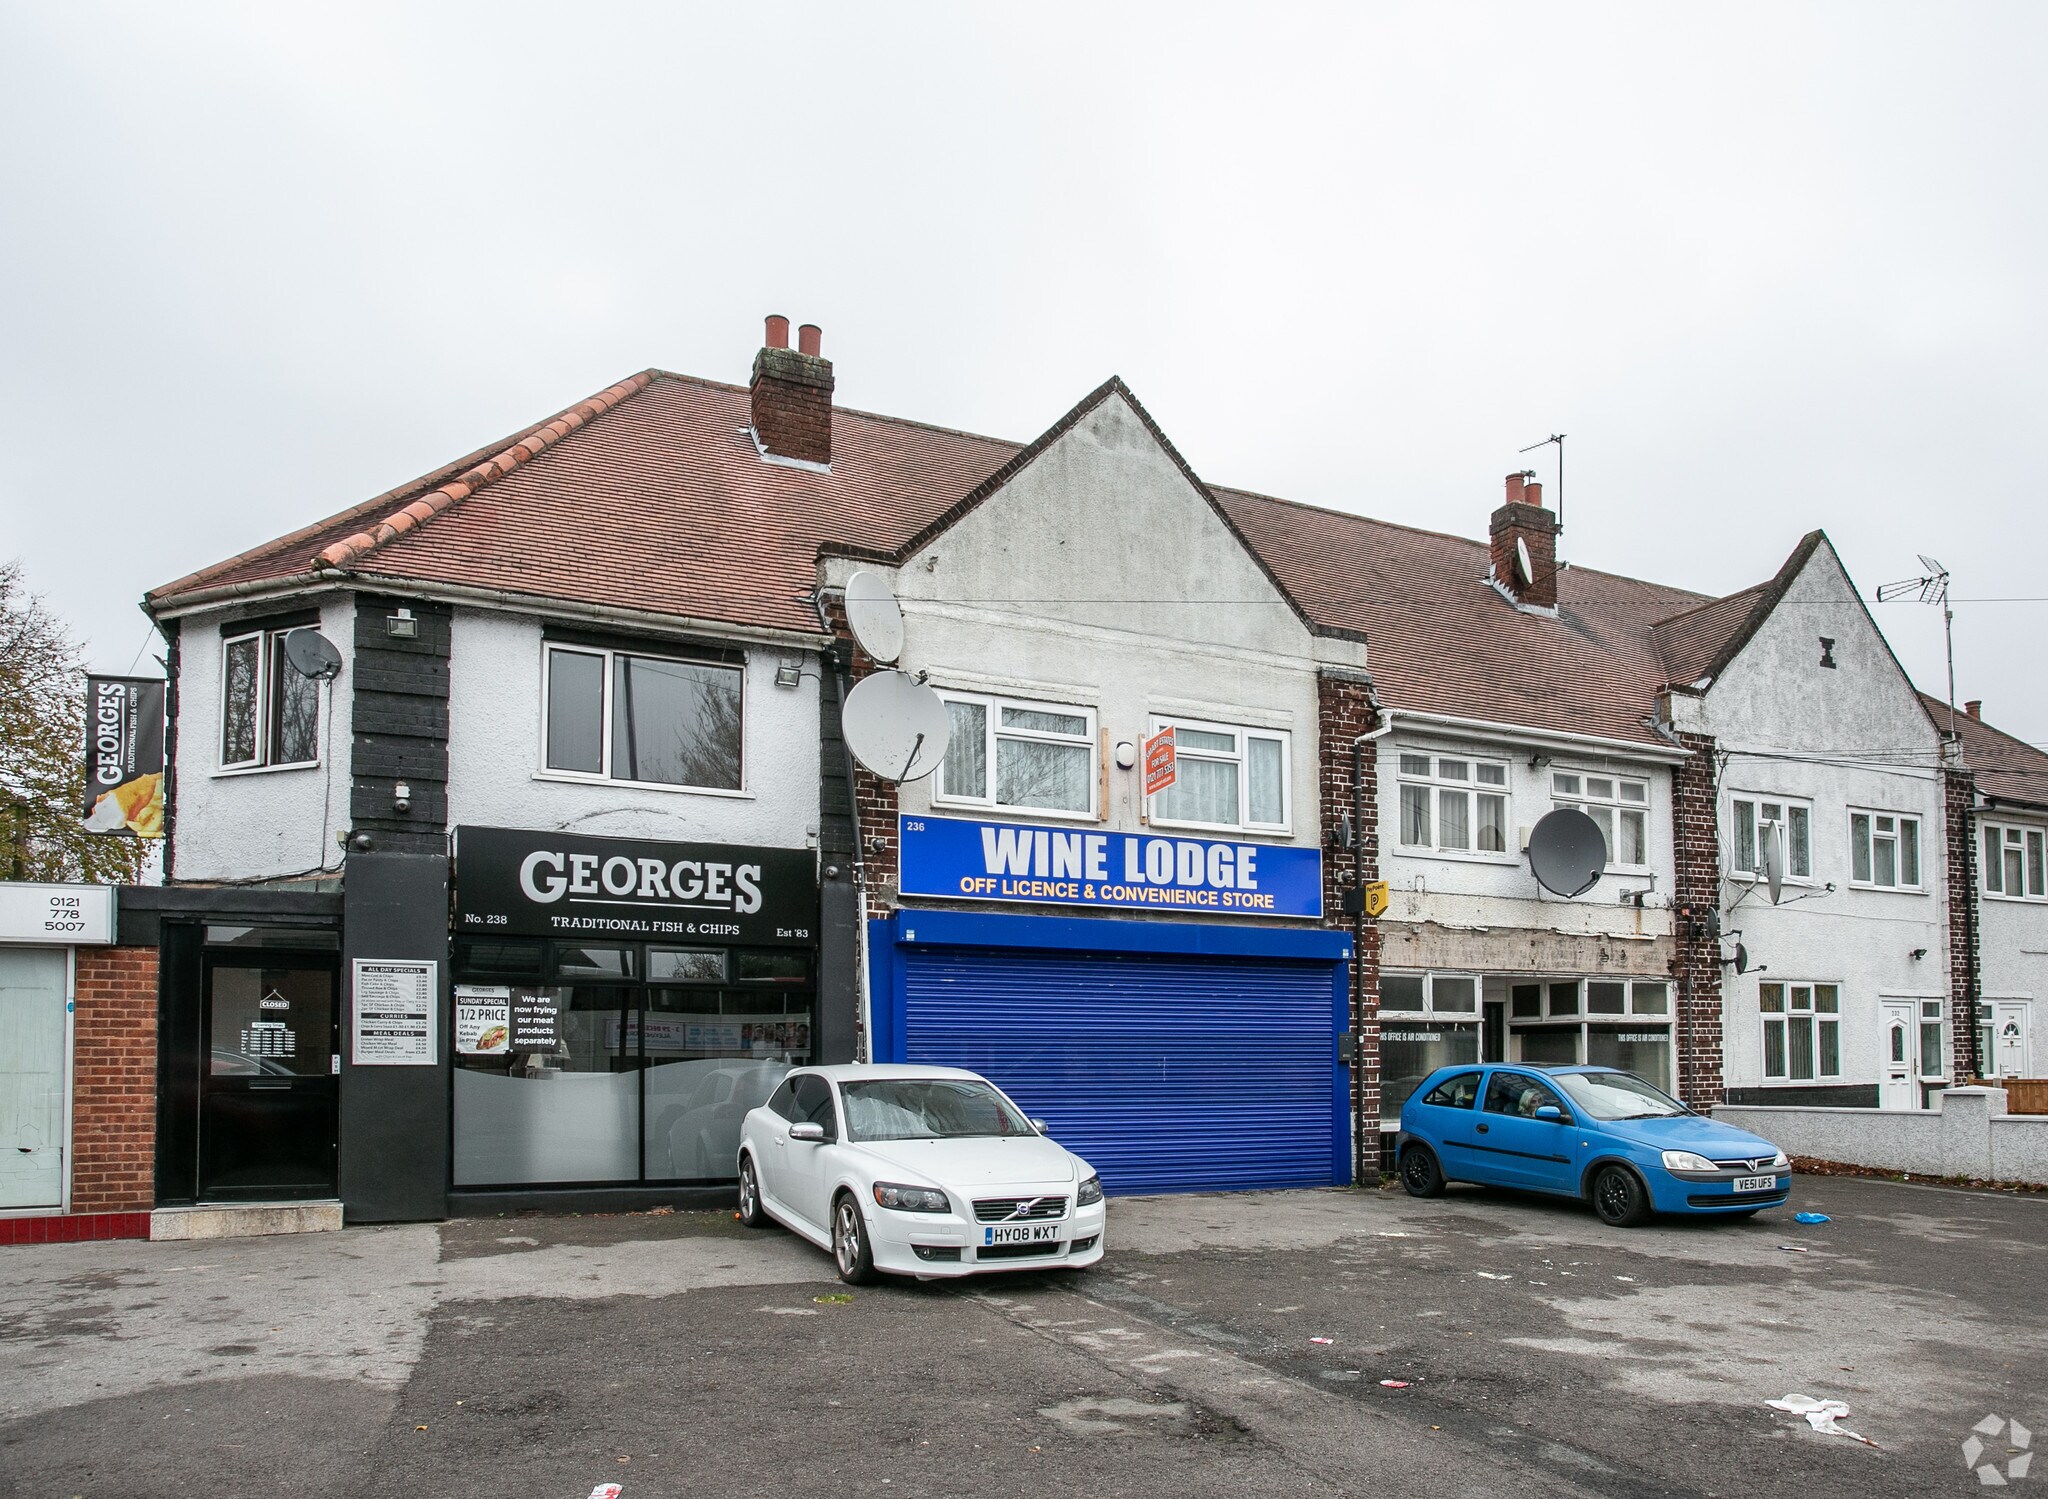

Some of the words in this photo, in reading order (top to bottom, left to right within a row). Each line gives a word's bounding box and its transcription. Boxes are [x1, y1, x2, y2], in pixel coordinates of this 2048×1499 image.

[130, 687, 138, 707] CHIPS
[96, 683, 126, 785] GEORGES
[128, 730, 137, 773] TRADITIONAL
[1159, 752, 1169, 764] SALE
[906, 822, 925, 832] 236
[981, 827, 1107, 880] WINE
[1125, 837, 1257, 890] LODGE
[520, 851, 762, 914] GEORGES
[1367, 883, 1384, 893] PayPoint
[960, 877, 996, 894] OFF
[1003, 880, 1079, 898] LICENCE
[1083, 884, 1096, 899] &
[1100, 886, 1218, 906] CONVENIENCE
[1222, 892, 1274, 908] STORE
[50, 897, 80, 906] 0121
[50, 910, 80, 919] 778
[465, 914, 483, 924] No.
[486, 914, 507, 925] 238
[45, 922, 85, 931] 5007
[551, 916, 648, 932] TRADITIONAL
[653, 921, 683, 933] FISH
[686, 923, 696, 933] &
[699, 923, 740, 935] CHIPS
[776, 928, 791, 937] Est
[794, 928, 808, 938] '83
[460, 1009, 475, 1020] 1/2
[479, 1009, 506, 1020] PRICE
[533, 1006, 557, 1014] frying
[517, 1027, 554, 1035] products
[1388, 1032, 1402, 1041] OFFICE
[1402, 1033, 1407, 1041] IS
[1415, 1033, 1441, 1041] CONDITIONED
[1626, 1034, 1637, 1042] OFFICE
[1638, 1034, 1641, 1042] IS
[1648, 1034, 1669, 1042] CONDITIONED
[1738, 1178, 1758, 1190] VE51
[1758, 1177, 1772, 1189] UFS
[995, 1228, 1030, 1242] HY08
[1034, 1226, 1058, 1239] WXT
